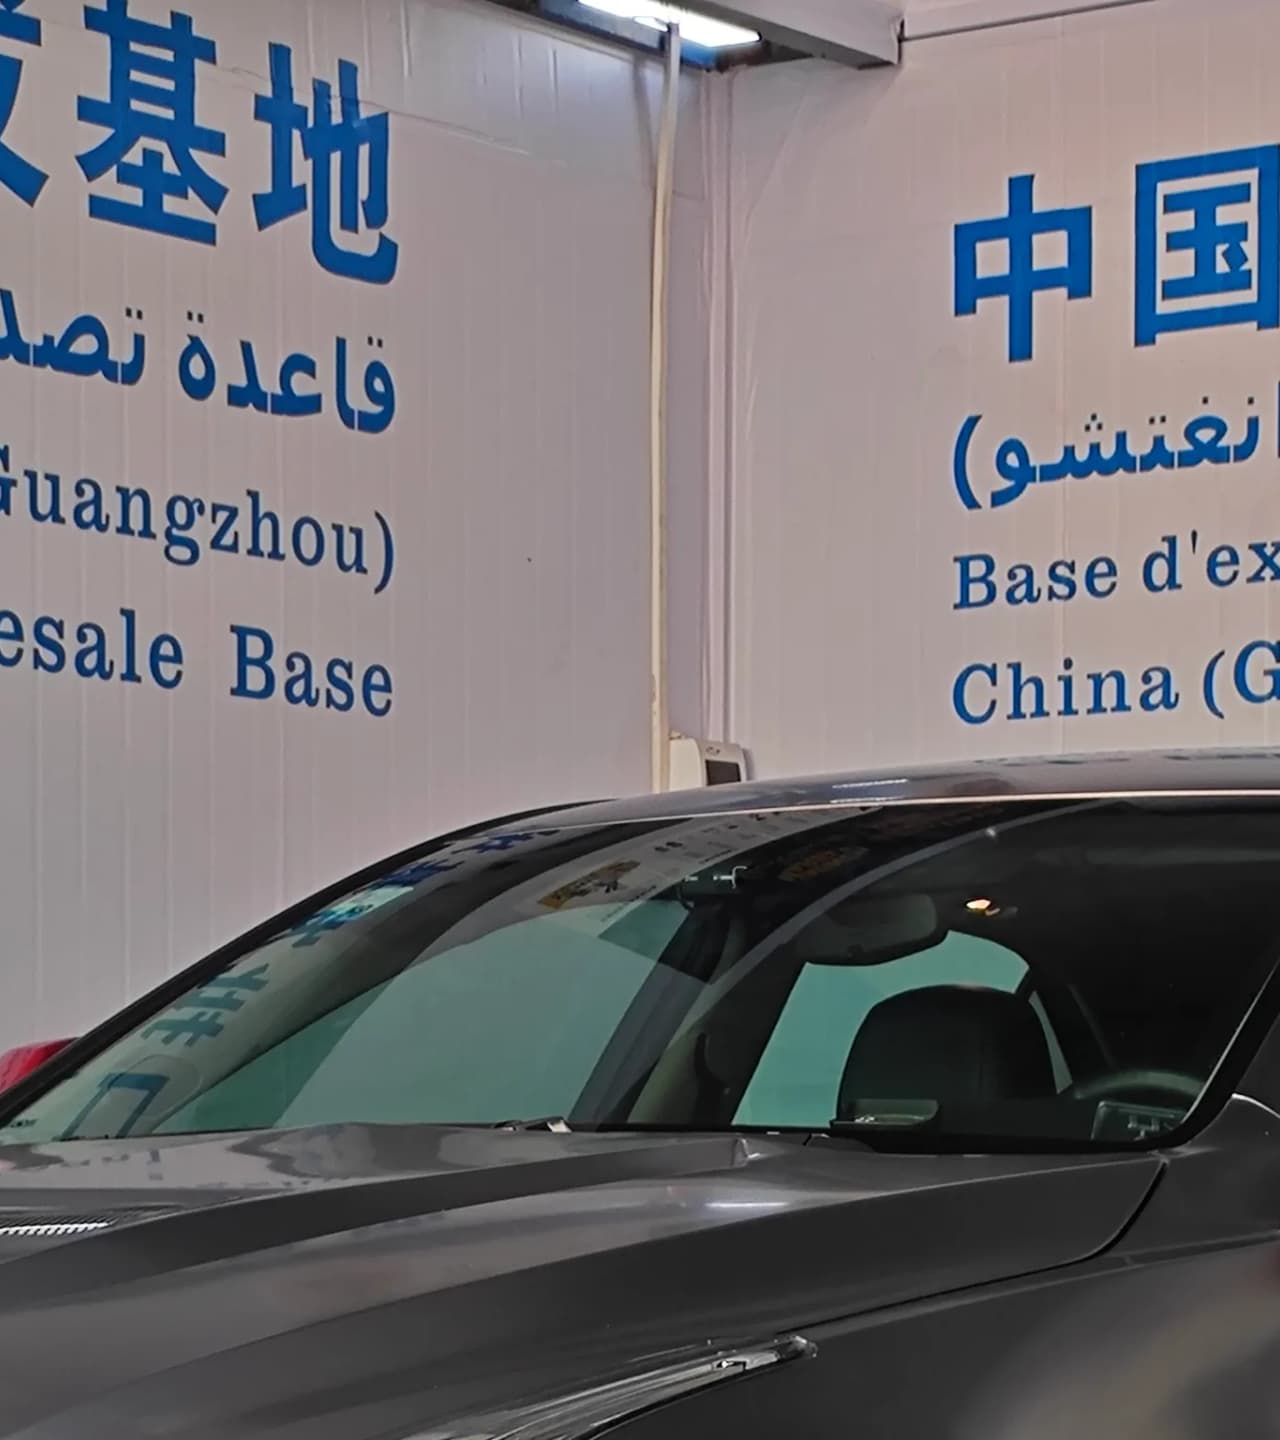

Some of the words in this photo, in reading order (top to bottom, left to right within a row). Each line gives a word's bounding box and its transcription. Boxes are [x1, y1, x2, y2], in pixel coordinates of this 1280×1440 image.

[177, 309, 398, 434] قاعدة
[952, 553, 1119, 610] Base
[229, 624, 395, 718] Base
[951, 656, 1180, 726] China
